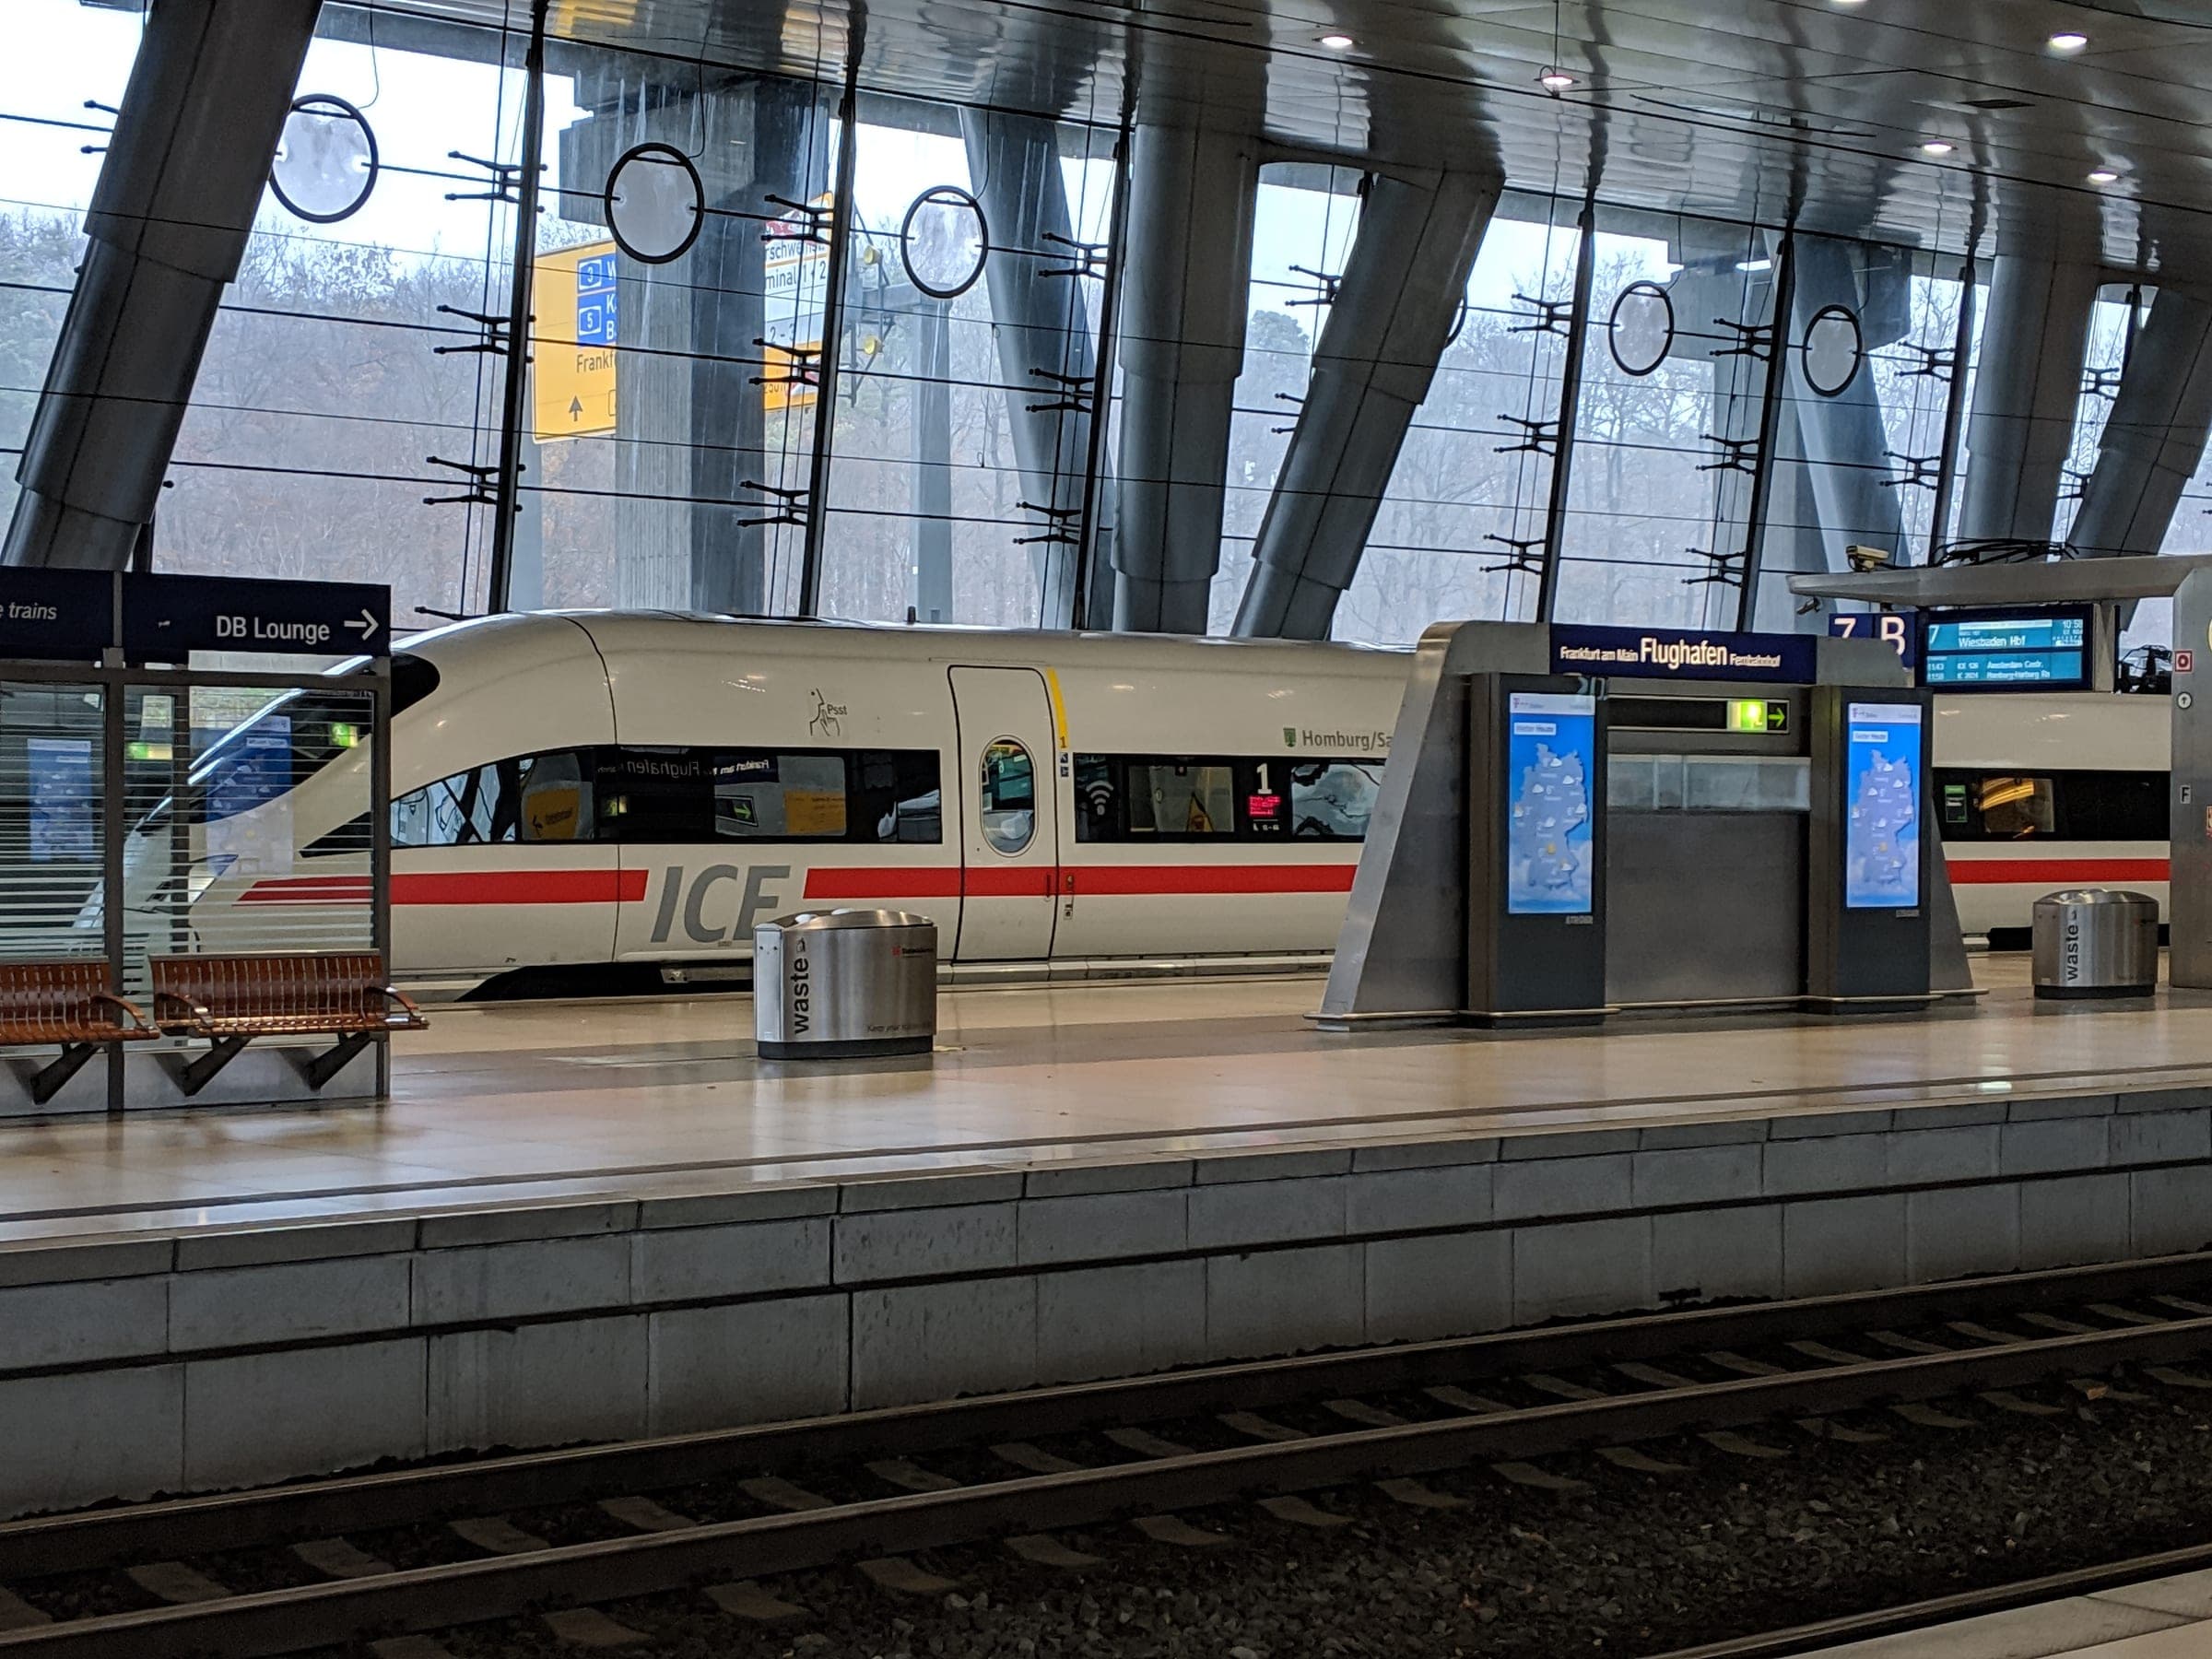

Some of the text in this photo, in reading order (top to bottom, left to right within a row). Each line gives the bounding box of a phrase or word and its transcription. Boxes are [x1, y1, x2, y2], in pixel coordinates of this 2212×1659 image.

[586, 266, 594, 284] 3
[819, 260, 827, 280] 2
[586, 312, 594, 329] 5
[577, 350, 617, 373] Frankf
[9, 602, 57, 620] trains
[216, 615, 330, 645] DB Lounge
[1881, 617, 1905, 655] B
[1929, 625, 1940, 644] 7
[1959, 636, 2006, 648] Wiesbaden
[1560, 646, 1601, 661] Frankfurt
[1602, 649, 1616, 661] am
[1641, 637, 1728, 671] Flughafen
[827, 703, 847, 716] Psst
[1060, 735, 1067, 749] 1
[1256, 762, 1273, 794] 1
[651, 865, 791, 943] ICE
[2065, 924, 2078, 982] waste
[791, 958, 809, 1034] waste
